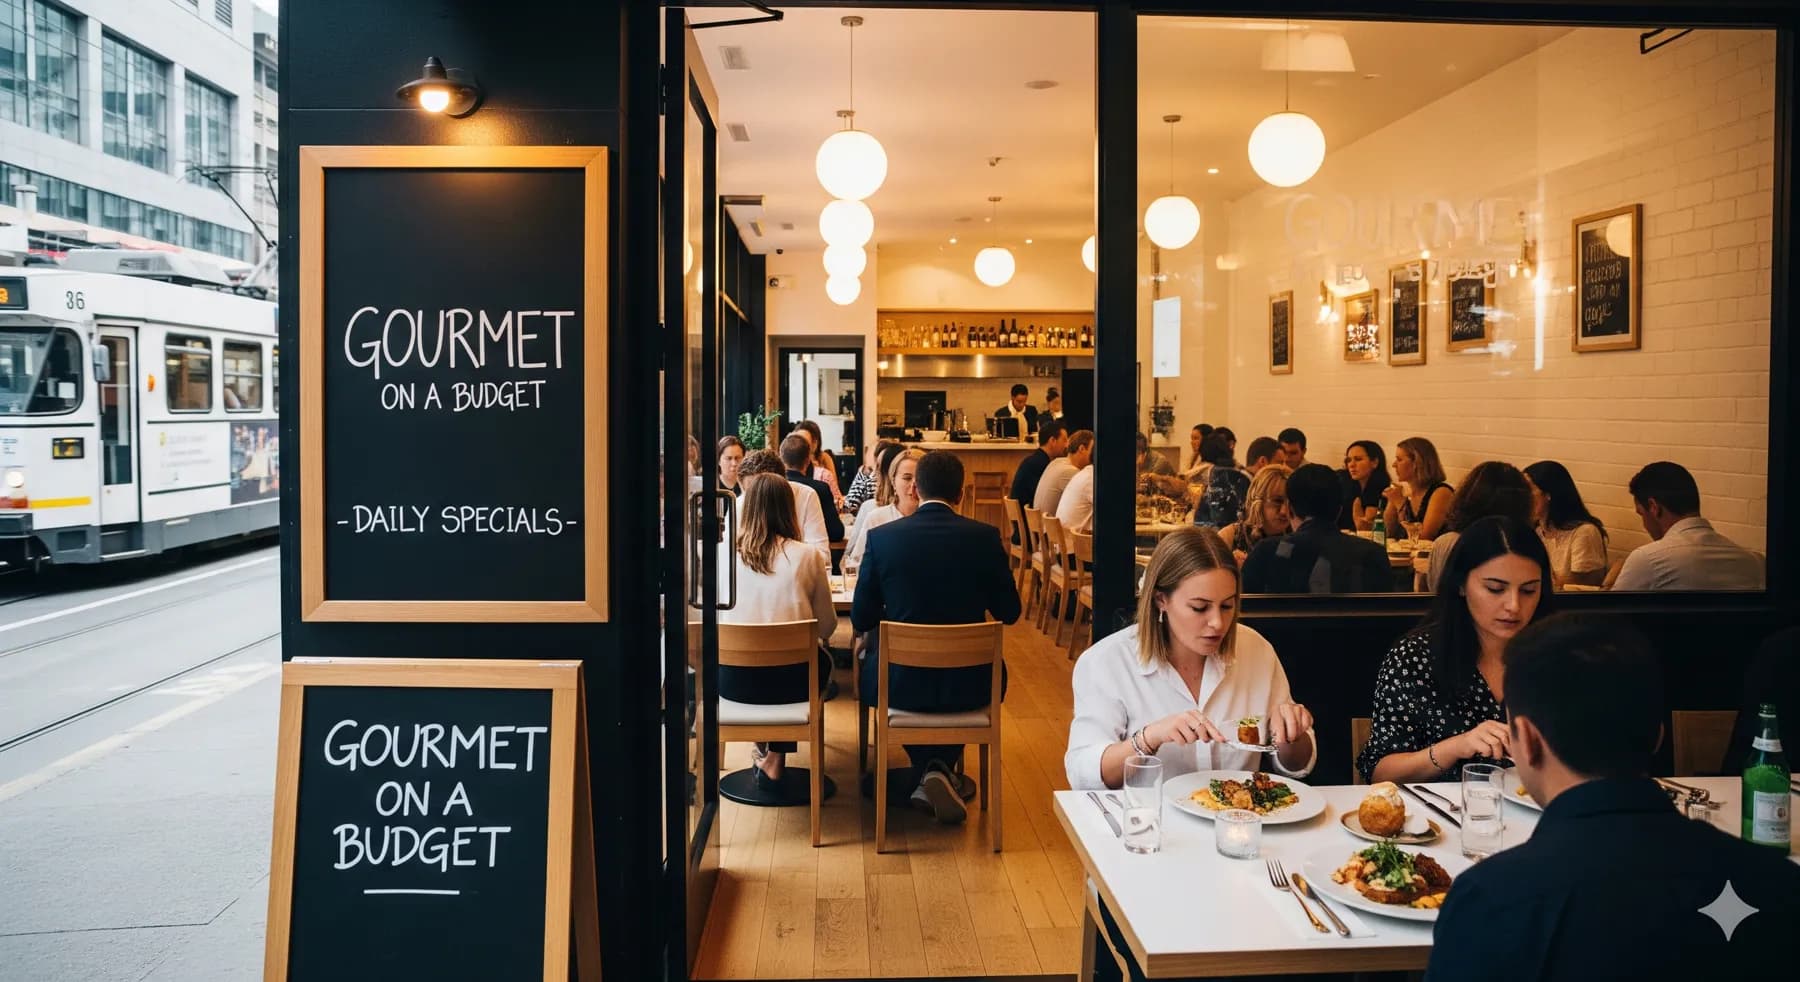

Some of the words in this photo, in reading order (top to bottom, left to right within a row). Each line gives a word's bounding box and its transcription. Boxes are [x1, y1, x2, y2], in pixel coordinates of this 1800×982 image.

[66, 290, 85, 310] 36
[345, 307, 574, 379] GOURMET
[381, 383, 414, 410] ON
[424, 383, 442, 409] A
[452, 380, 546, 412] BUDGET
[324, 720, 547, 771] GOURMET
[376, 781, 430, 816] ON
[443, 782, 473, 816] A
[333, 824, 511, 872] BUDGET
